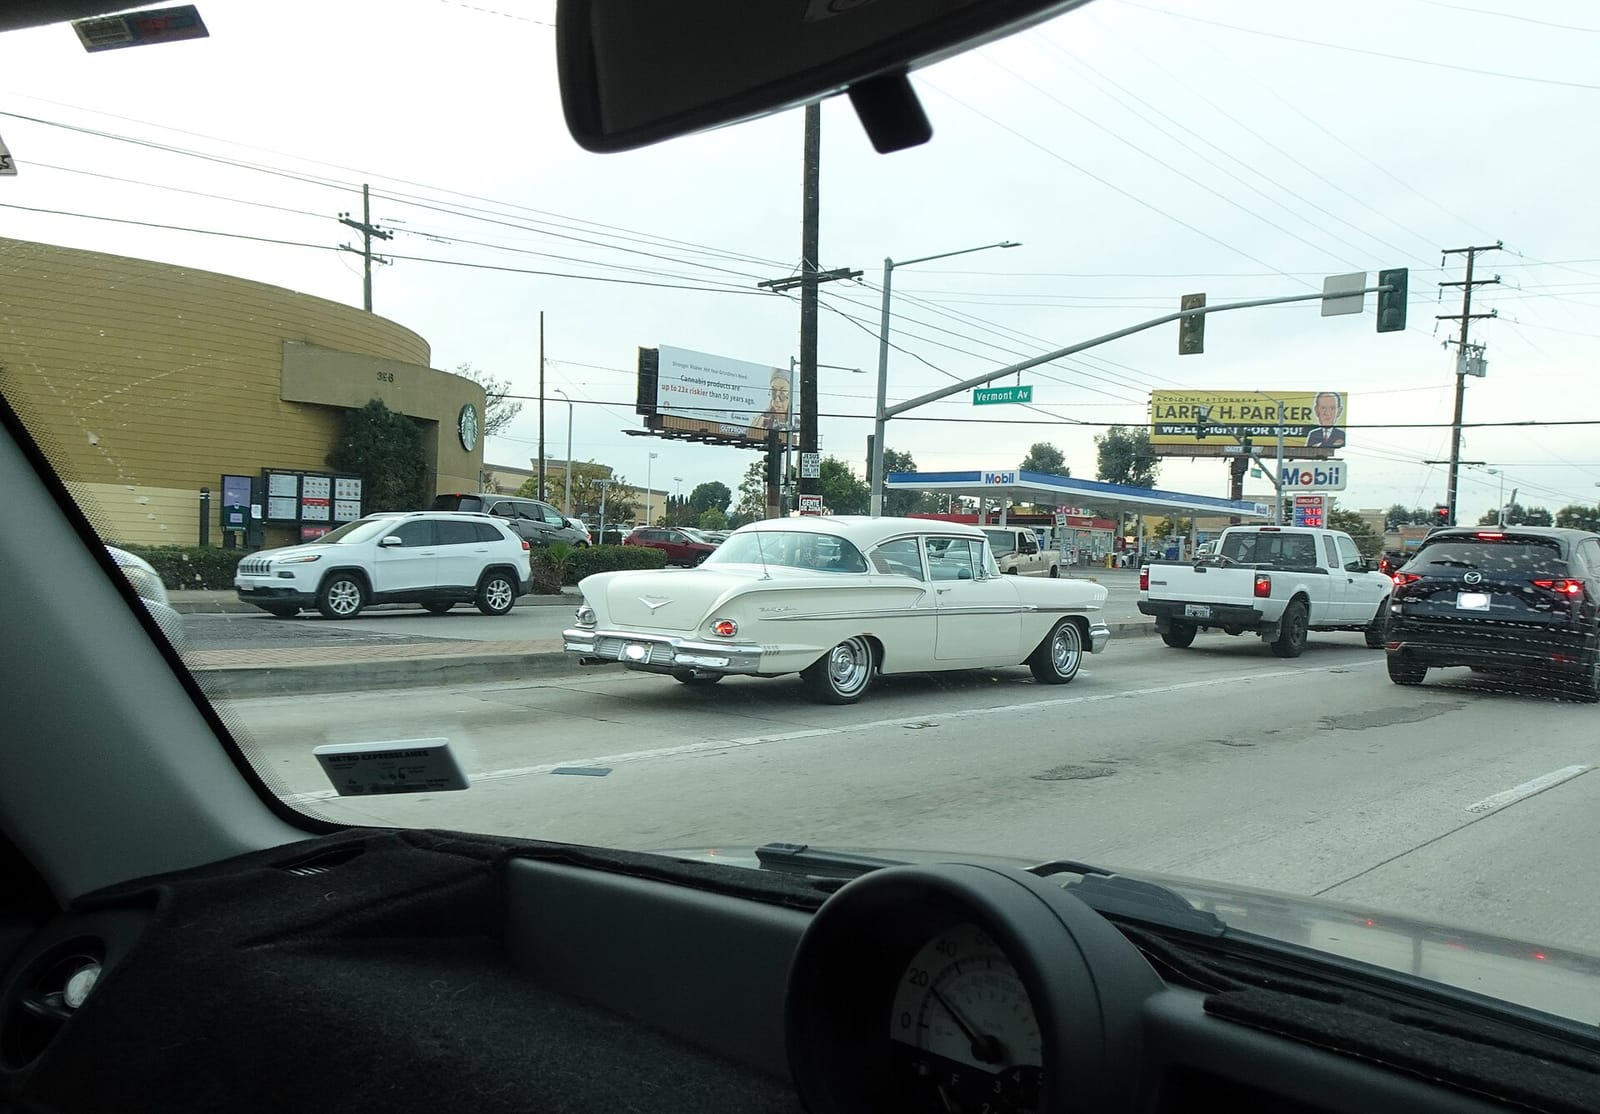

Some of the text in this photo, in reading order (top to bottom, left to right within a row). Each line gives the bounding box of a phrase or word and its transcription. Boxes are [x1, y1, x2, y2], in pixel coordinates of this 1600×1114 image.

[680, 374, 706, 385] Cannabis
[707, 378, 731, 390] products
[689, 387, 708, 396] riskier
[730, 395, 743, 403] years
[976, 390, 1028, 401] Vermont Av
[1220, 406, 1236, 419] H.
[985, 473, 1014, 484] Mobil
[1282, 467, 1339, 485] Mobil
[936, 939, 956, 957] 40
[909, 968, 929, 986] 20
[901, 1012, 911, 1028] 0
[1012, 1071, 1020, 1082] 4
[993, 1081, 1001, 1094] 3
